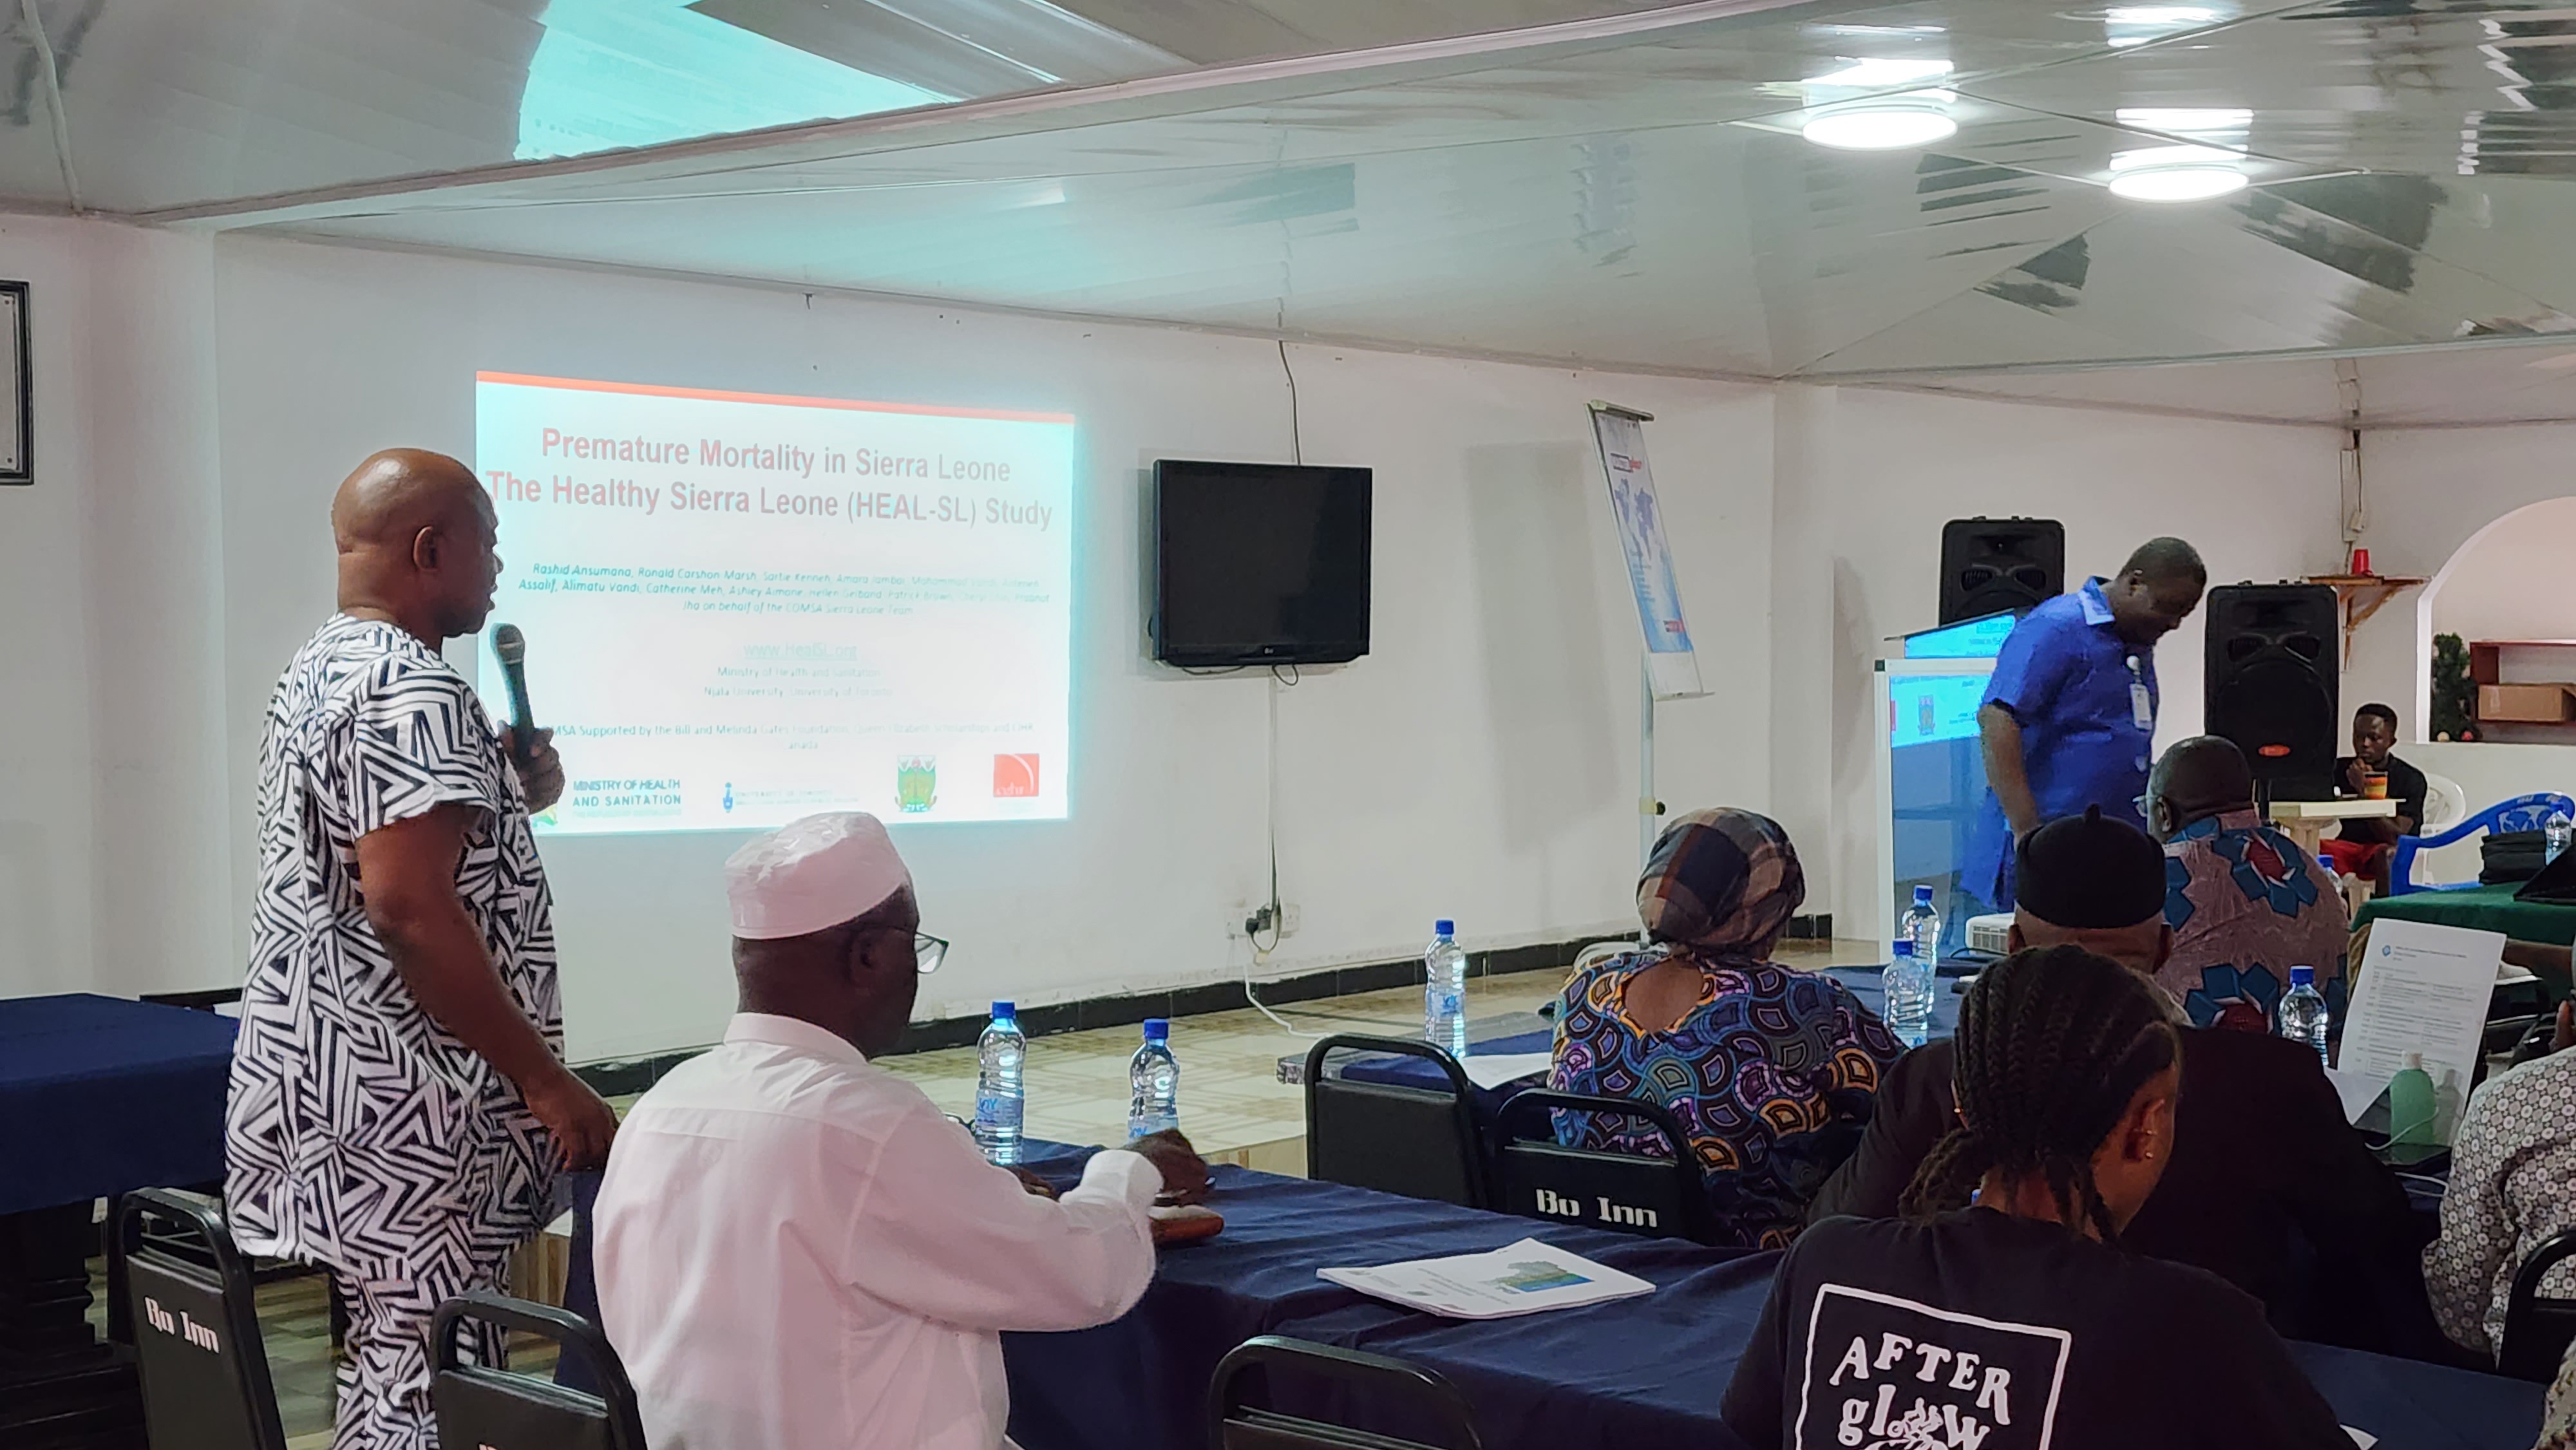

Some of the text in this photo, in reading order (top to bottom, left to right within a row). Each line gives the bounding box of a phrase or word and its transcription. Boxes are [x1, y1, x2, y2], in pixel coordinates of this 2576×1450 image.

[542, 427, 1011, 482] Premature Mortality in Sierra Leone
[486, 470, 1053, 532] The Healthy Sierra Leone (HEAL-SL) Study
[533, 563, 571, 576] Rashid
[571, 565, 634, 579] Ansumana,
[638, 567, 675, 578] Ronald
[562, 579, 605, 592] Alimatu
[646, 582, 696, 594] Catherine
[728, 585, 762, 598] Ashley
[703, 603, 715, 611] on
[719, 601, 751, 614] behalf
[753, 601, 764, 614] of
[767, 603, 782, 612] the
[786, 603, 822, 613] COMSA
[826, 603, 853, 614] Sierra
[857, 605, 884, 614] Leone
[888, 605, 913, 615] Team
[717, 666, 759, 679] Ministry
[762, 667, 772, 677] of
[775, 667, 808, 677] Health
[811, 668, 829, 677] and
[704, 686, 730, 697] Njala
[842, 687, 852, 697] of
[551, 725, 576, 736] MSA
[579, 725, 636, 738] Supported
[639, 725, 652, 738] by
[655, 725, 671, 735] the
[675, 725, 691, 735] Bill
[694, 725, 712, 735] and
[716, 725, 757, 735] Melinda
[573, 778, 681, 791] MINISTRY OF HEALTH
[573, 794, 681, 807] AND SANITATION
[1536, 1189, 1658, 1228] Bo Inn
[145, 1296, 220, 1353] Bo Inn
[1829, 1332, 2011, 1425] AFTER
